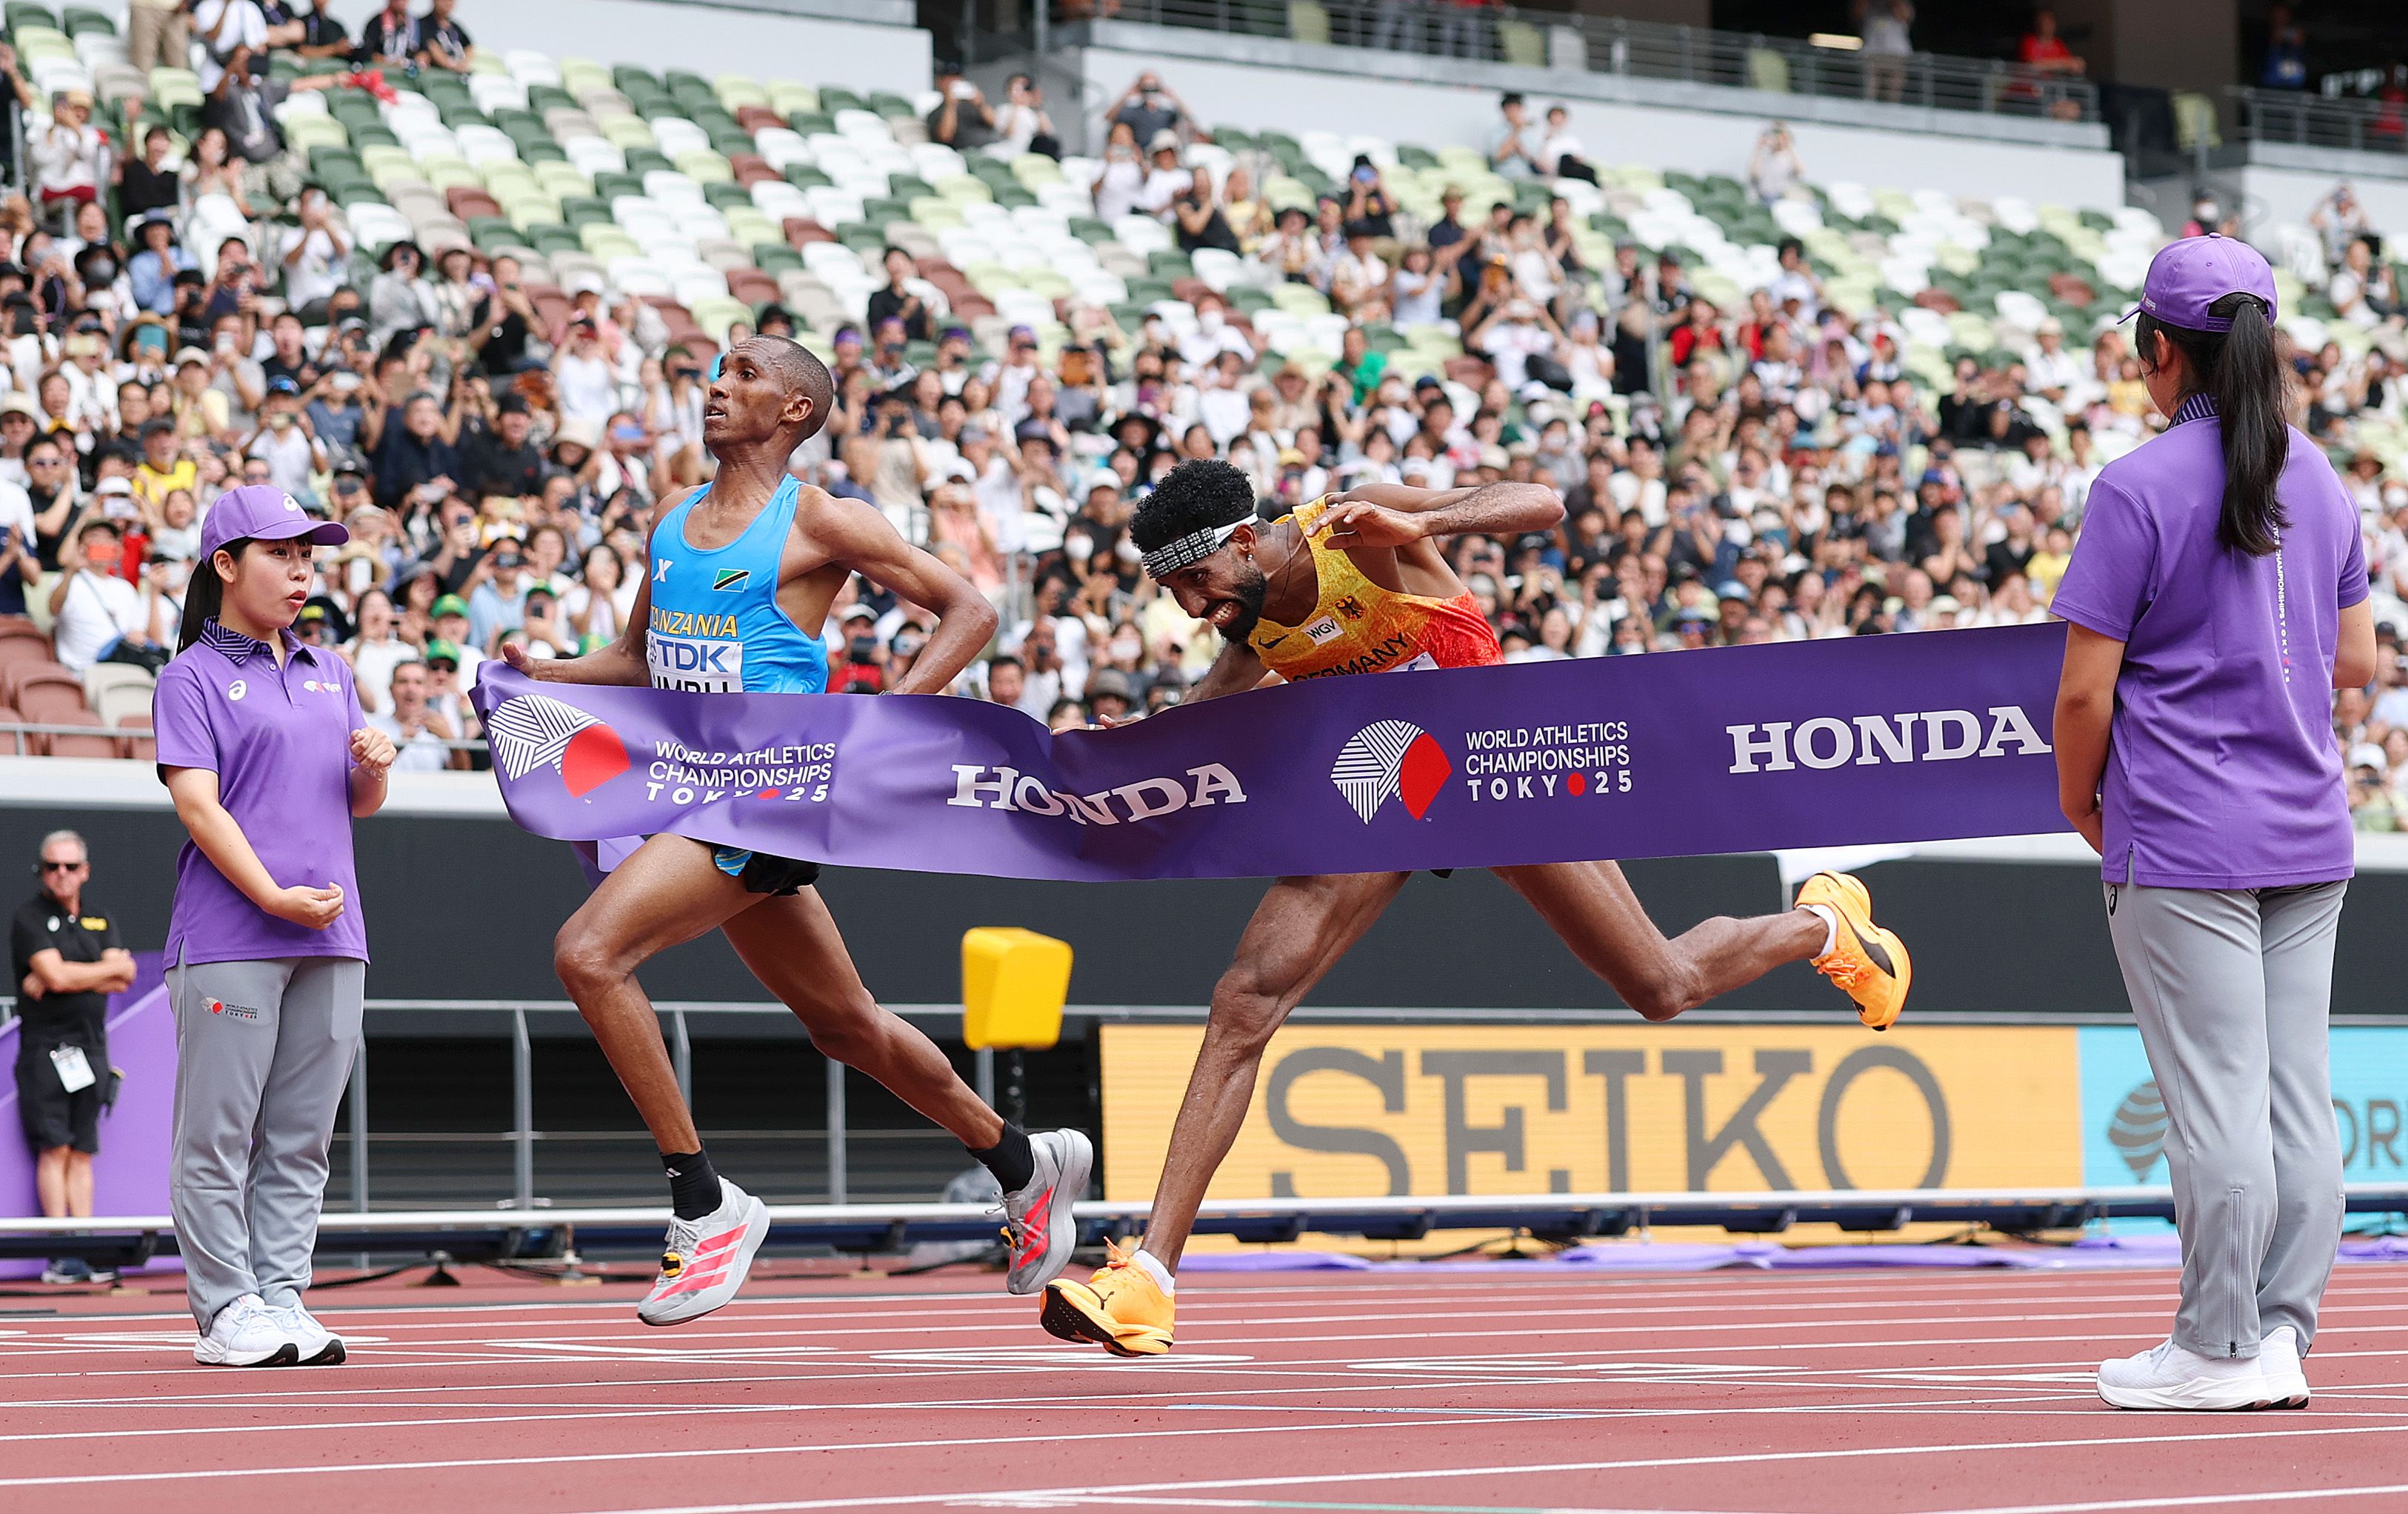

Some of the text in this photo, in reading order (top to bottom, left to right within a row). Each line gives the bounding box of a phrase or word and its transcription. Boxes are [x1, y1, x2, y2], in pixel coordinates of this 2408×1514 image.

[650, 604, 738, 637] TANZANIA
[1306, 619, 1336, 639] WGV
[656, 639, 730, 673] TDK
[1466, 721, 1629, 750] WORLD ATHLETICS
[1726, 705, 2052, 774] HONDA
[656, 741, 836, 766] WORLD ATHLETICS
[1466, 744, 1630, 775] CHAMPIONSHIPS
[649, 761, 832, 788] CHAMPIONSHIPS
[947, 762, 1247, 825] HONDA
[1266, 1044, 1950, 1197] SEIKO
